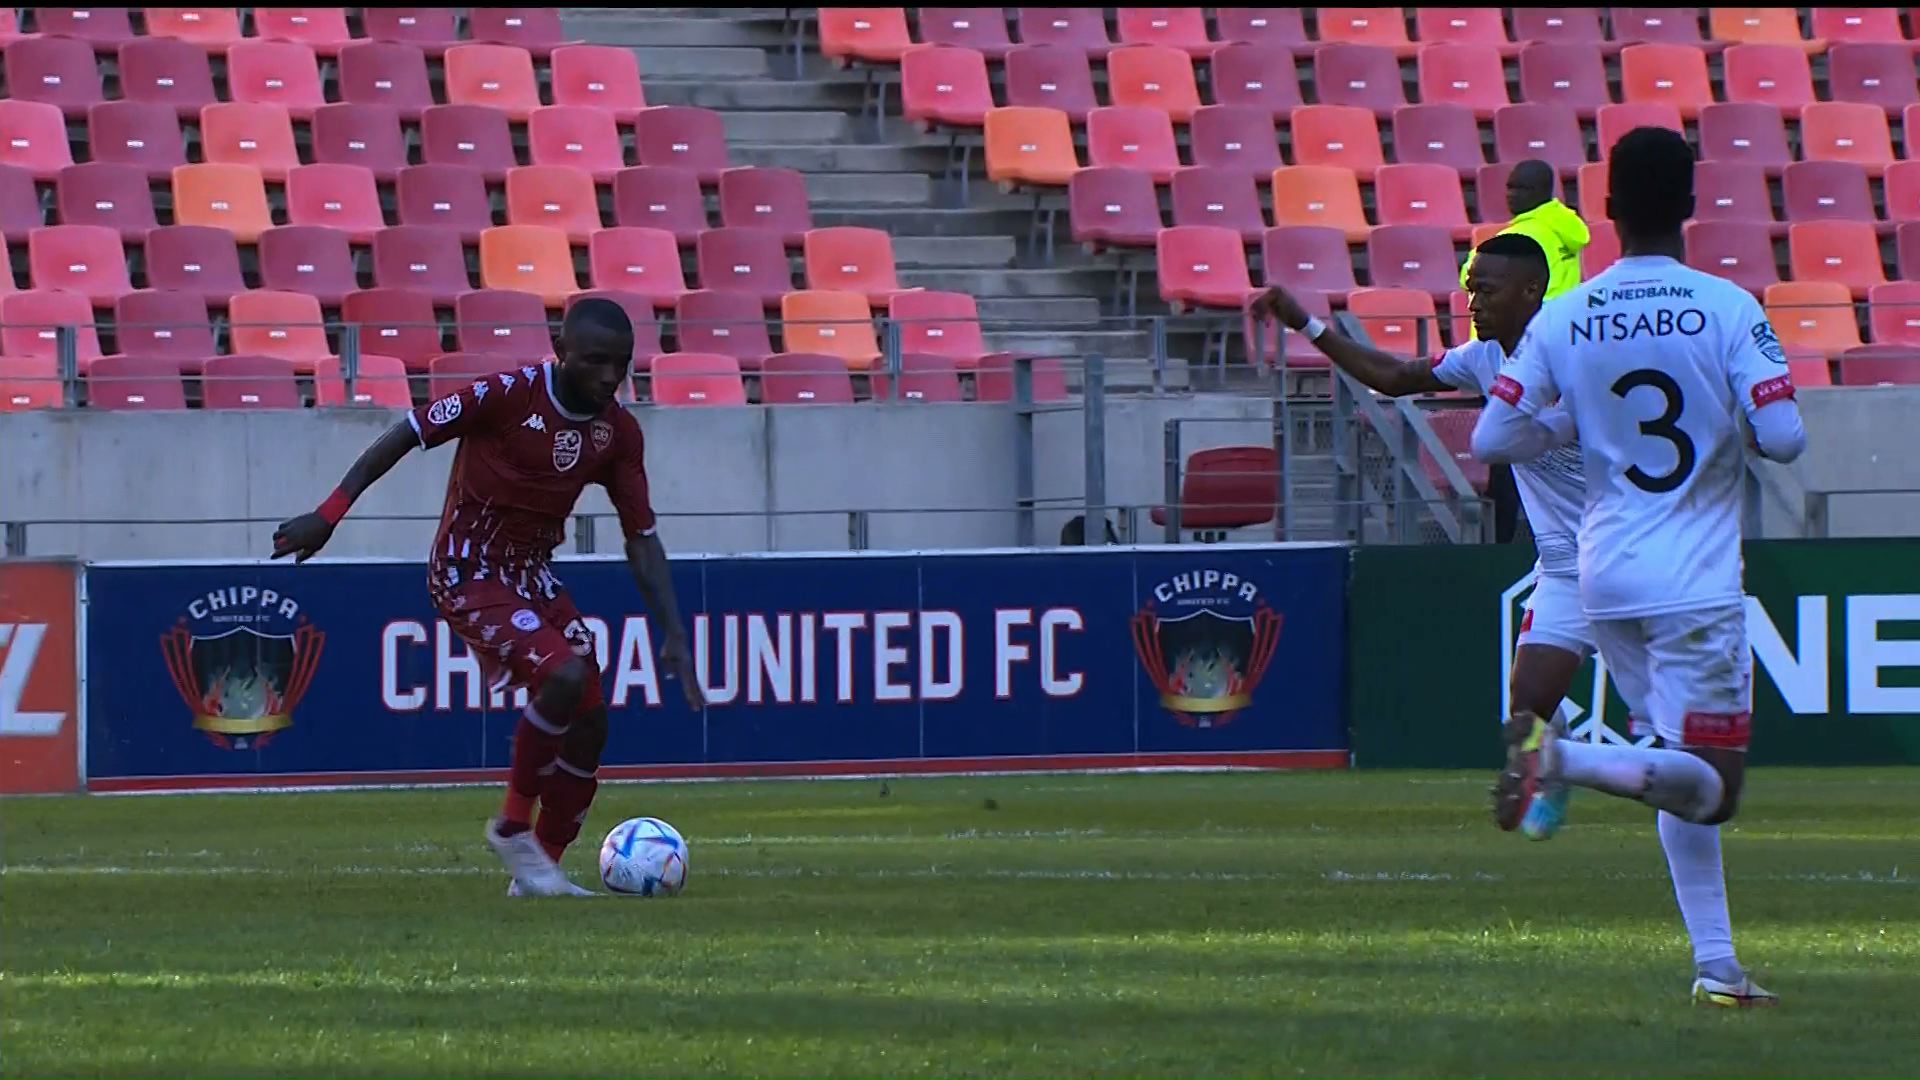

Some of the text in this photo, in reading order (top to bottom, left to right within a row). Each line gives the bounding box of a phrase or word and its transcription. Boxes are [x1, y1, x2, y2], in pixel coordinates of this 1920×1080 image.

[1611, 286, 1695, 301] NEDBANK
[1570, 308, 1706, 346] NTSABO
[1610, 368, 1697, 493] 3
[188, 586, 299, 619] CHIPPA
[1154, 569, 1258, 602] CHIPPA
[694, 611, 964, 704] UNITED
[995, 607, 1083, 698] FC
